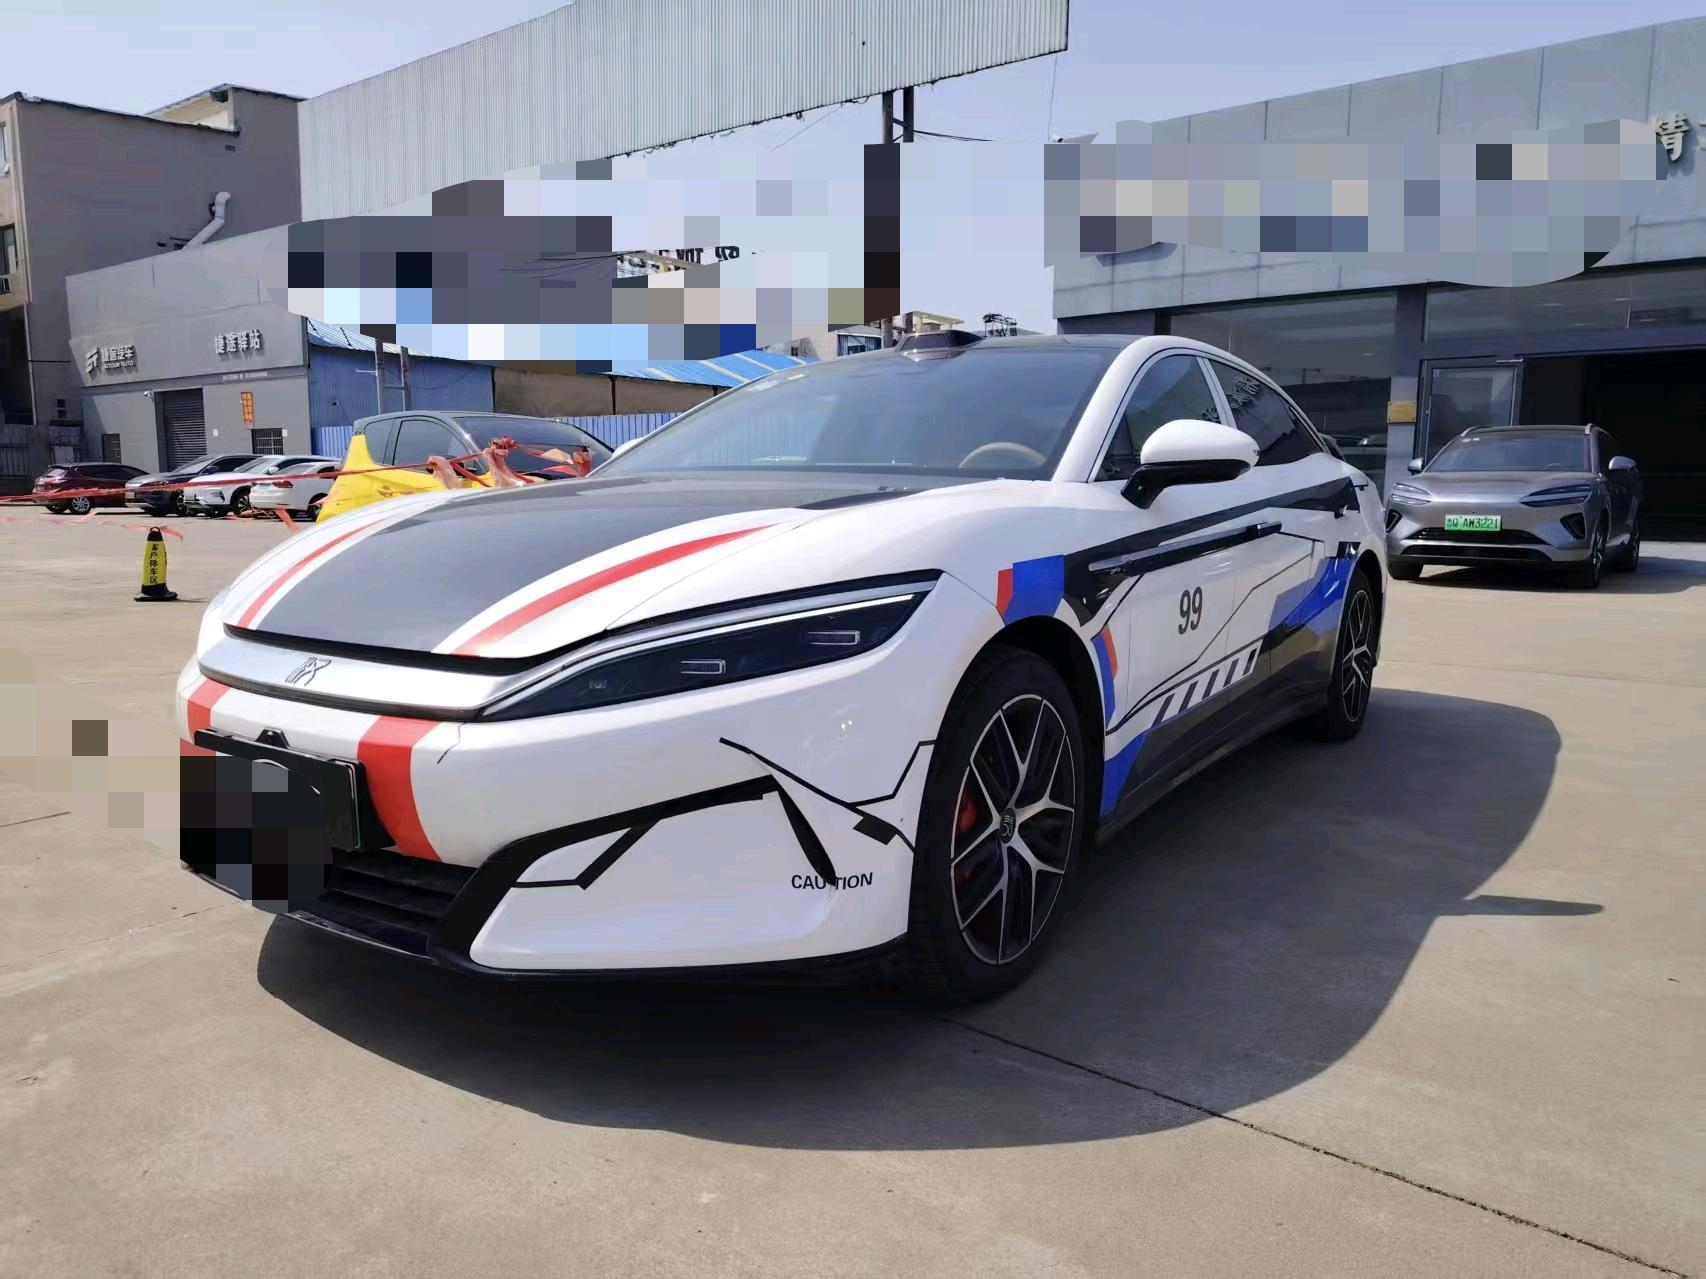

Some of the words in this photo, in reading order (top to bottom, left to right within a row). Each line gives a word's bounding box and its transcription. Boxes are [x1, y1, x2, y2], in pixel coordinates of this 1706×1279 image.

[149, 543, 159, 584] 客户停车区
[1178, 586, 1203, 635] 99
[791, 872, 873, 890] CAUTION
